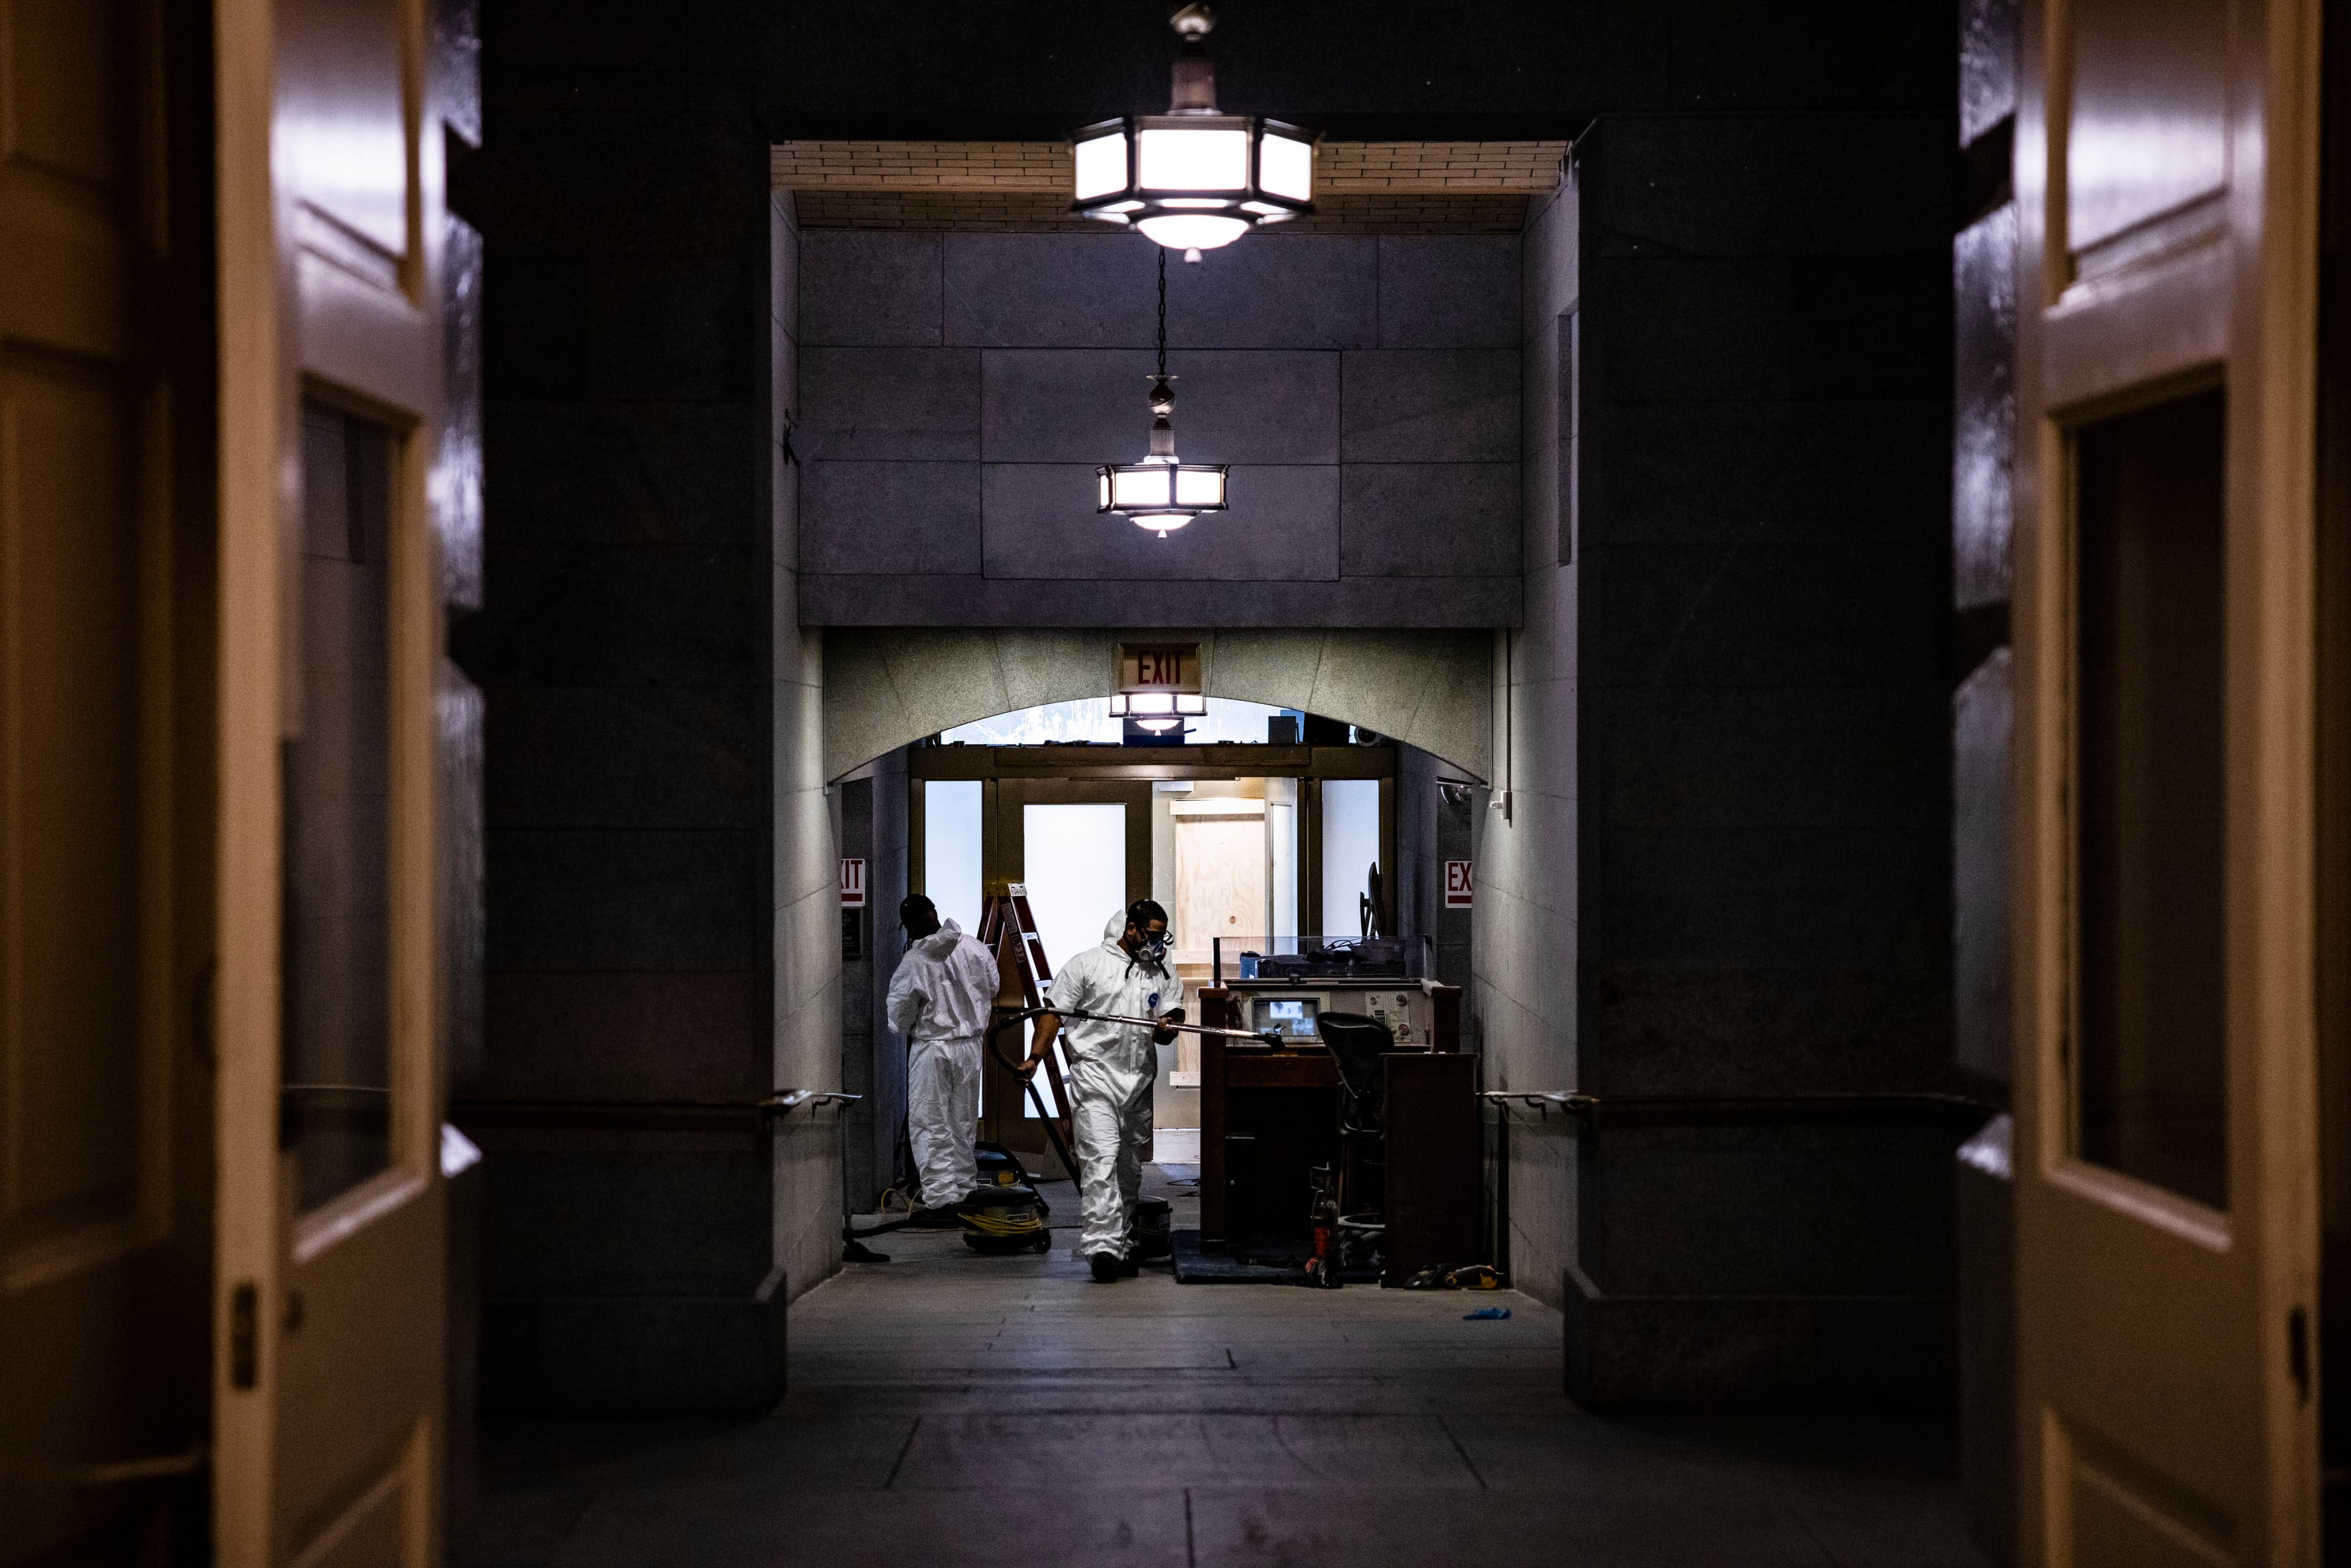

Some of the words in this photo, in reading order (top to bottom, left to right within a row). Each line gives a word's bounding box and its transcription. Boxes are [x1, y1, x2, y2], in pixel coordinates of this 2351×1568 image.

[1139, 651, 1183, 684] EXIT
[842, 860, 863, 888] IT
[1449, 862, 1472, 891] EX
